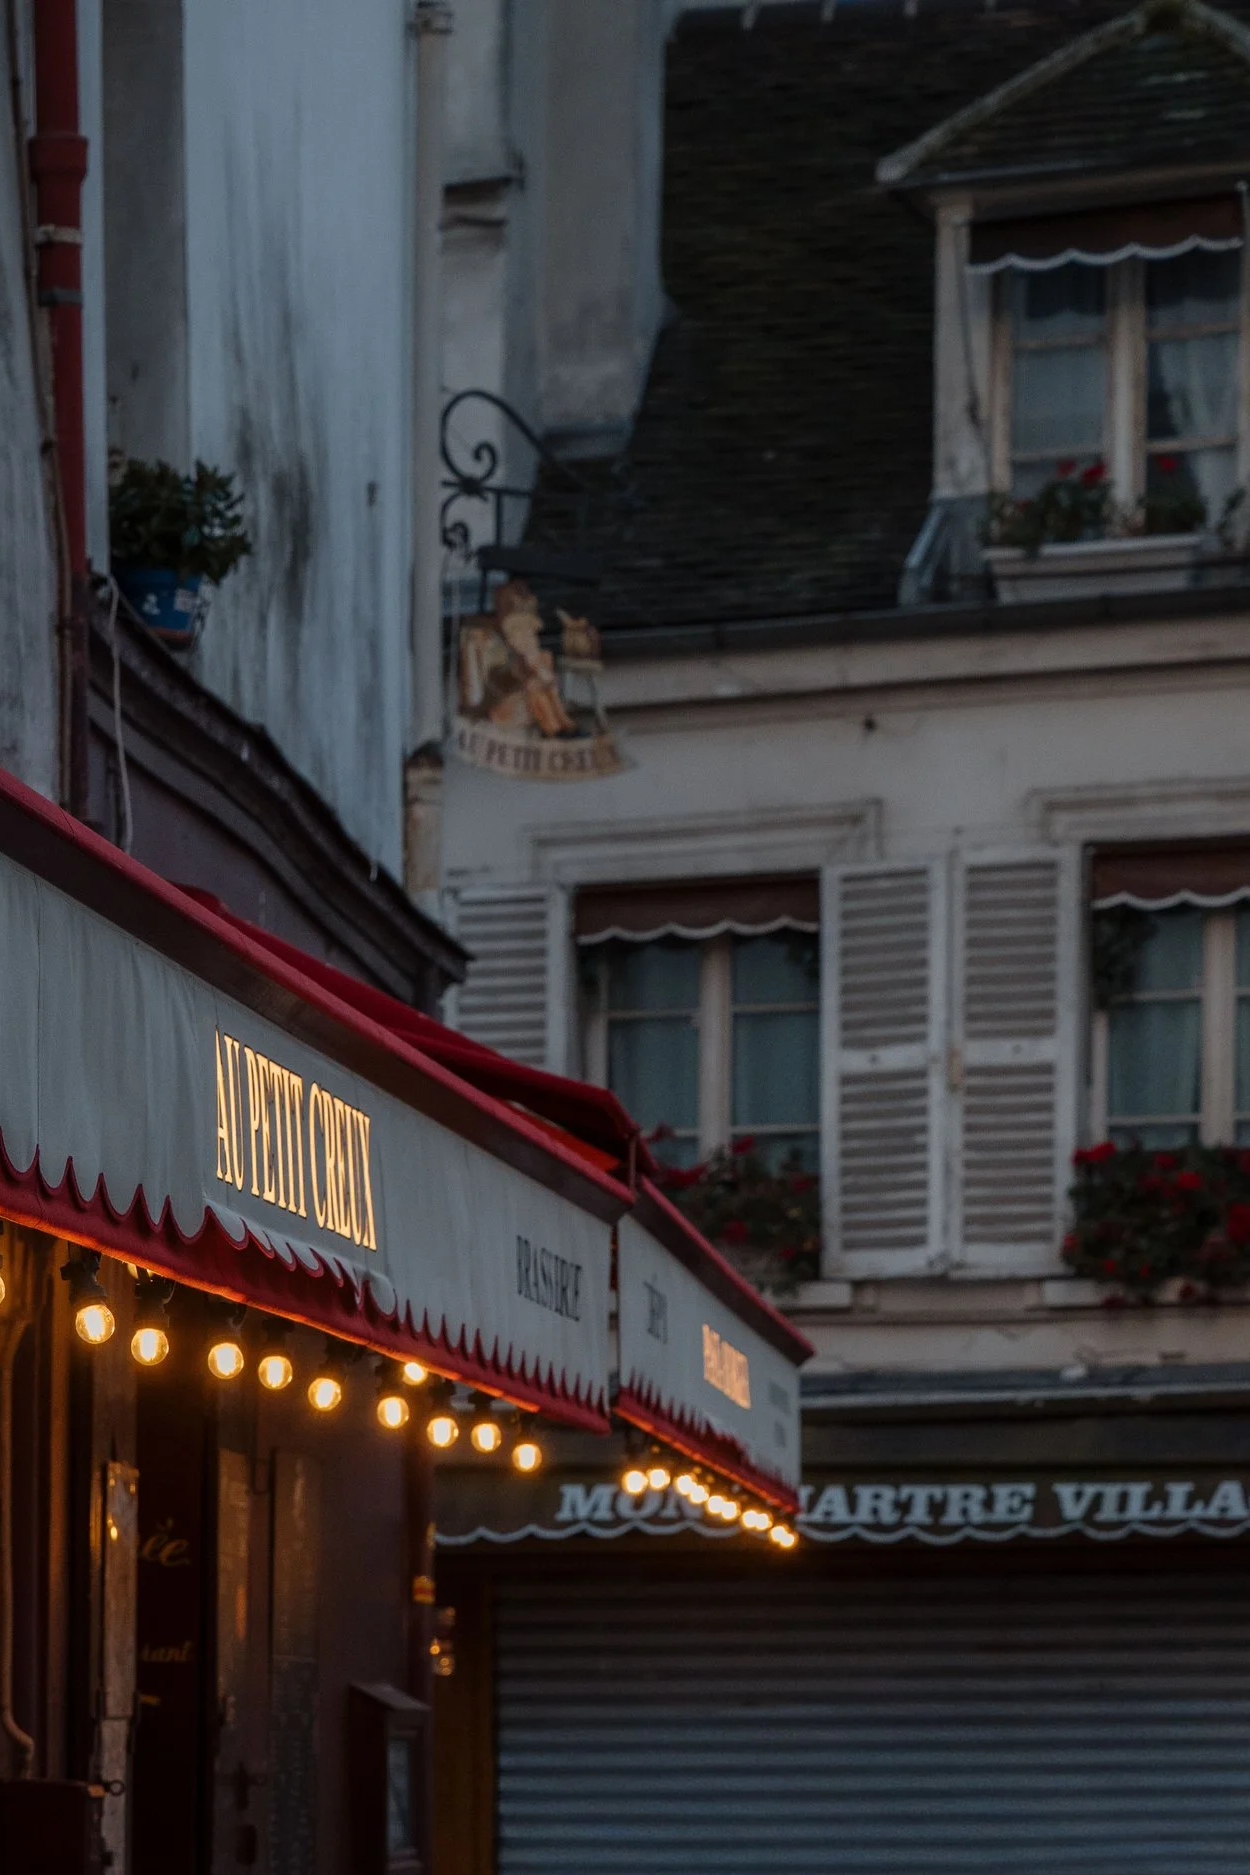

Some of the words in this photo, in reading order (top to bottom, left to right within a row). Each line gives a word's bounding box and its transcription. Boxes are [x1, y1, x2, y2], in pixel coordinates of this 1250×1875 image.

[215, 1024, 244, 1192] AU
[244, 1045, 307, 1219] PETIT
[309, 1081, 377, 1251] CREUX
[516, 1234, 582, 1321] BRASSERIE
[1052, 1480, 1250, 1523] VILLA
